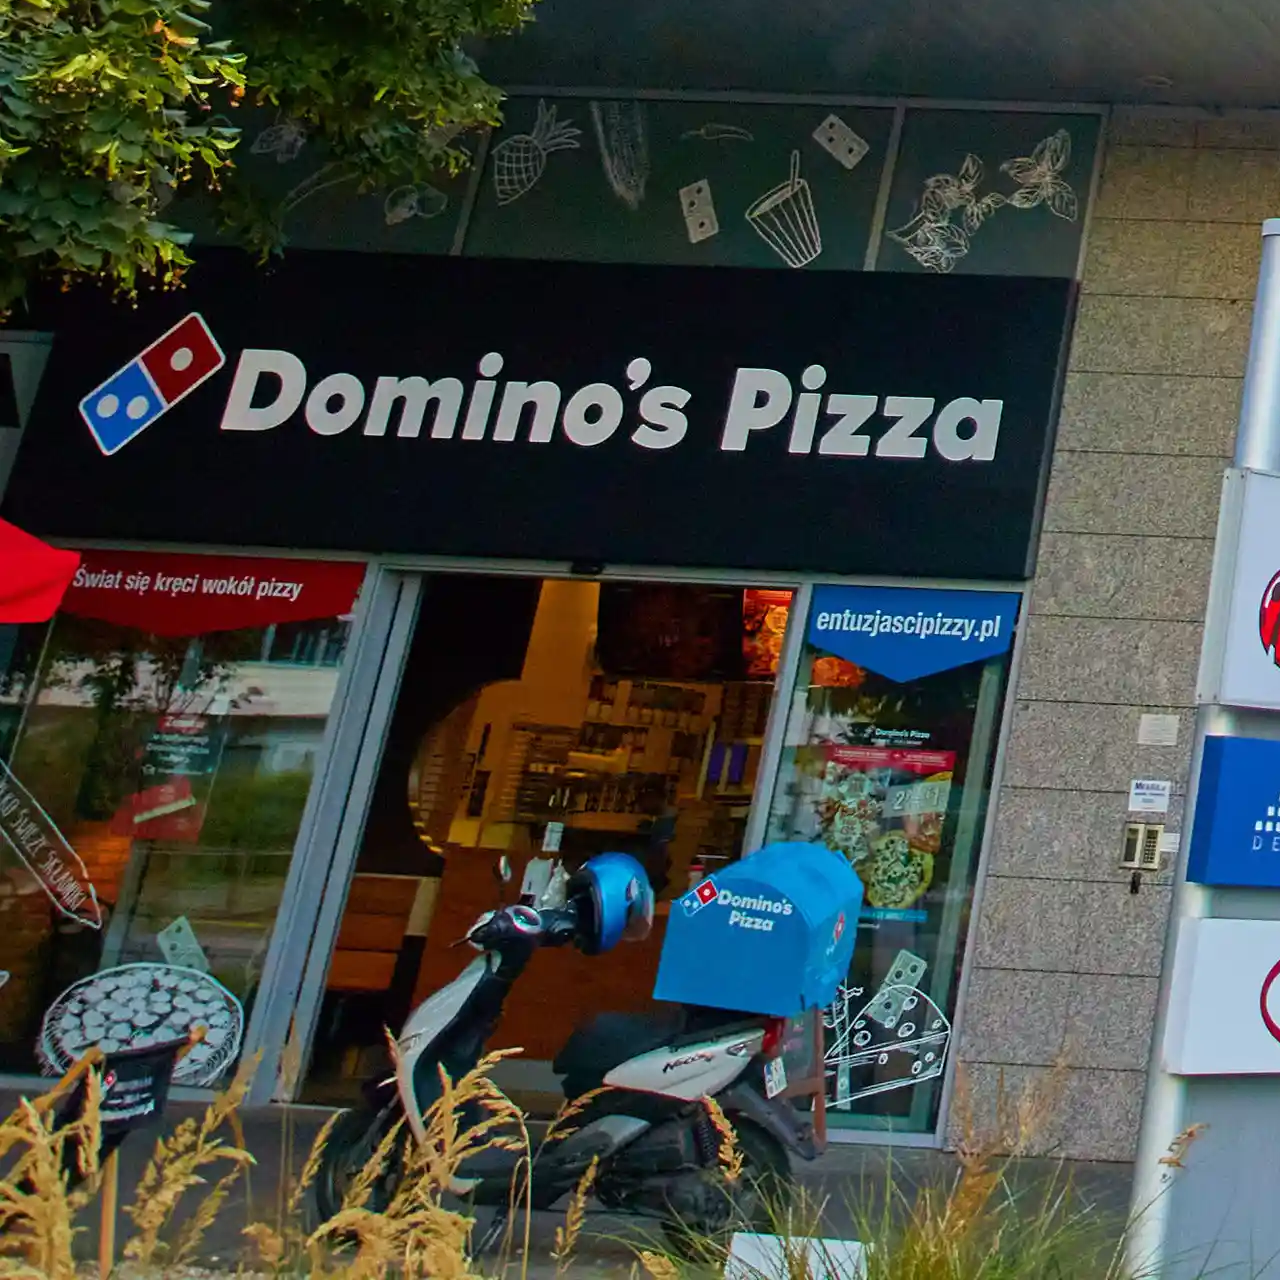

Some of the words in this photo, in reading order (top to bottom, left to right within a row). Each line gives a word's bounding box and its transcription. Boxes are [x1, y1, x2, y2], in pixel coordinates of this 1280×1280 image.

[220, 348, 693, 449] Domino's
[721, 364, 1004, 461] Pizza
[72, 564, 122, 589] Świat
[124, 571, 151, 596] się
[153, 572, 200, 597] kręci
[202, 575, 255, 596] wokół
[256, 578, 304, 602] pizzy
[816, 609, 1001, 642] entuzjascipizzy.pl
[717, 889, 794, 916] Domino's
[728, 910, 775, 932] Pizza
